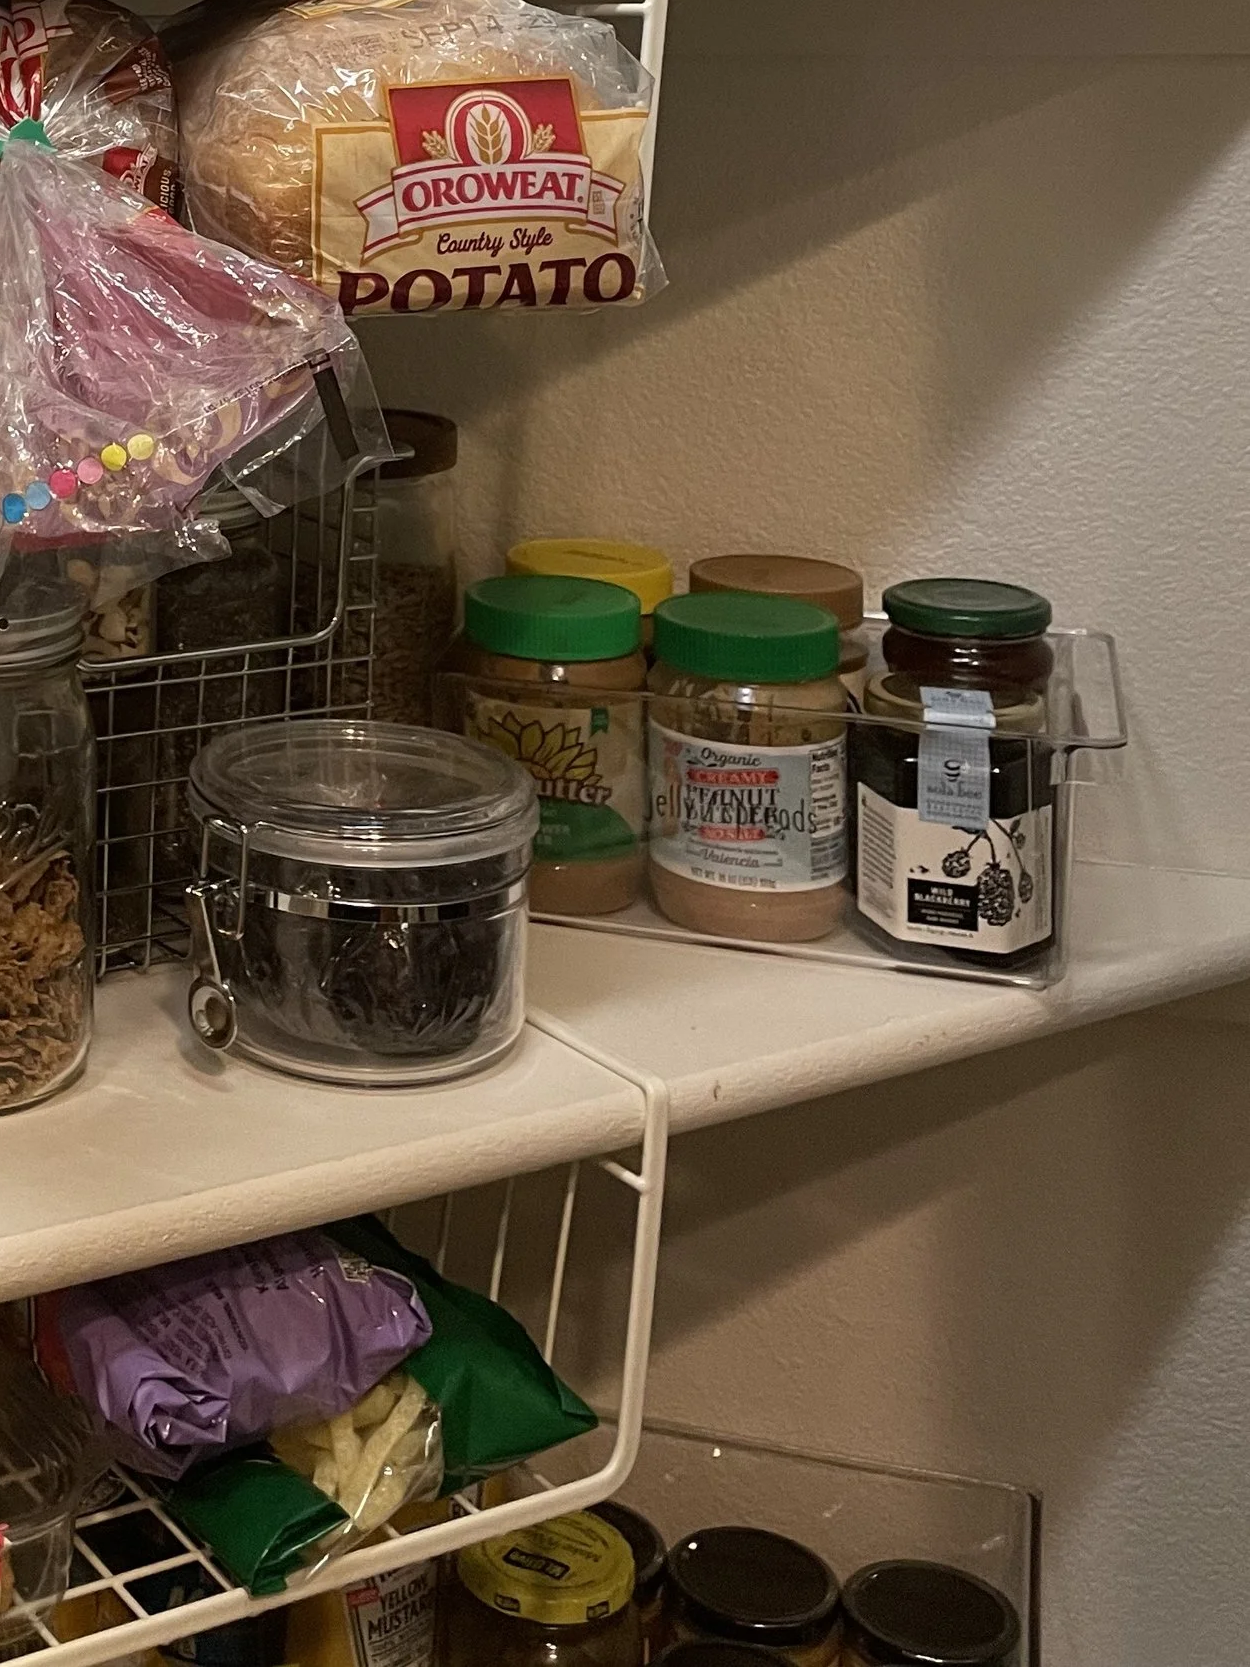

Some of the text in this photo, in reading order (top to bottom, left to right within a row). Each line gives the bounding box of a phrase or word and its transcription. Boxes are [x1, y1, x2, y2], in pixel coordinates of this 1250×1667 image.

[160, 166, 173, 209] ICIOUS.
[401, 170, 581, 212] OROWEAT
[436, 226, 553, 258] Country Style
[337, 253, 637, 316] POTATO
[700, 747, 762, 768] Organic
[696, 771, 768, 785] CREAMY
[685, 785, 780, 807] PEANUT
[701, 848, 760, 869] Valencia
[913, 892, 971, 908] BLACKBERRY
